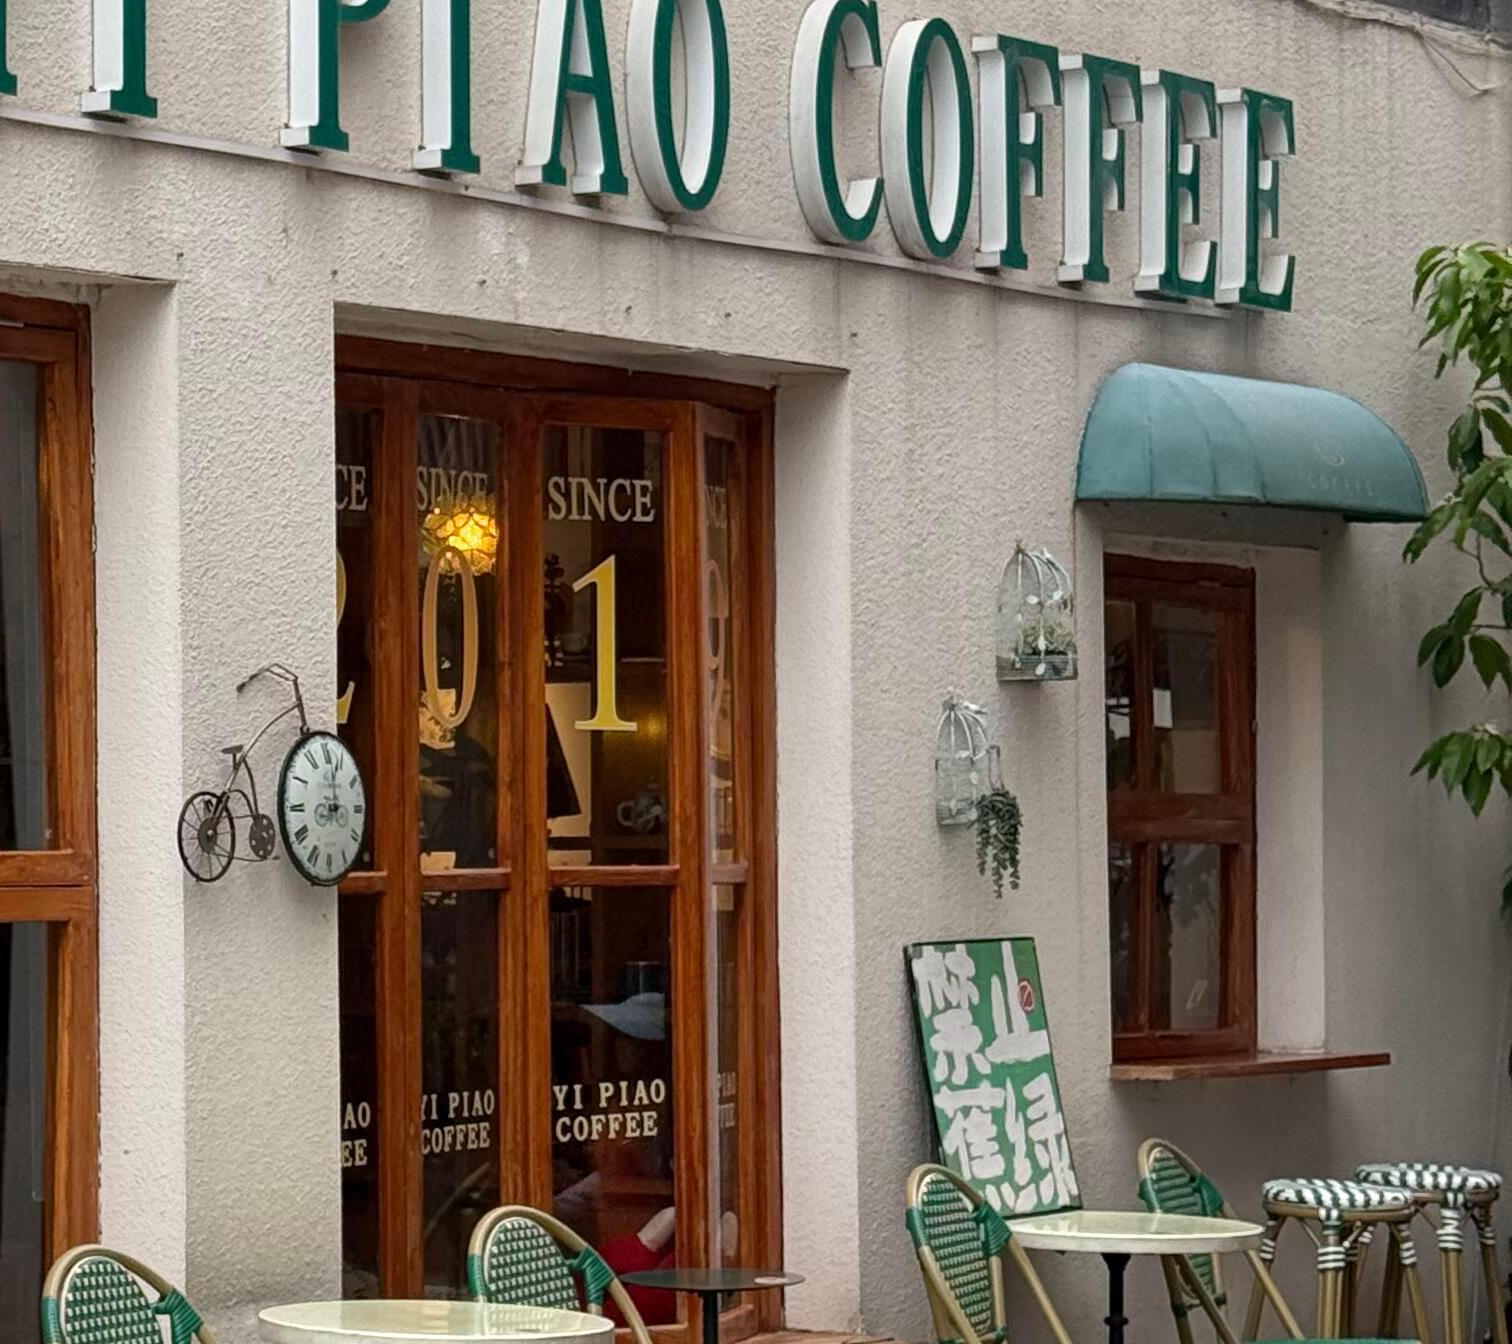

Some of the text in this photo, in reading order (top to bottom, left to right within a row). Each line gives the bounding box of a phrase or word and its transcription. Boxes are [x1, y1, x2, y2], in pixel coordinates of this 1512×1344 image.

[548, 475, 656, 523] SINCE
[572, 553, 638, 733] 1
[448, 1089, 496, 1119] PIAO
[552, 1078, 666, 1111] YI PIAO
[343, 1101, 371, 1130] AO
[555, 1111, 658, 1143] COFFEE
[420, 1122, 491, 1155] COFFEE
